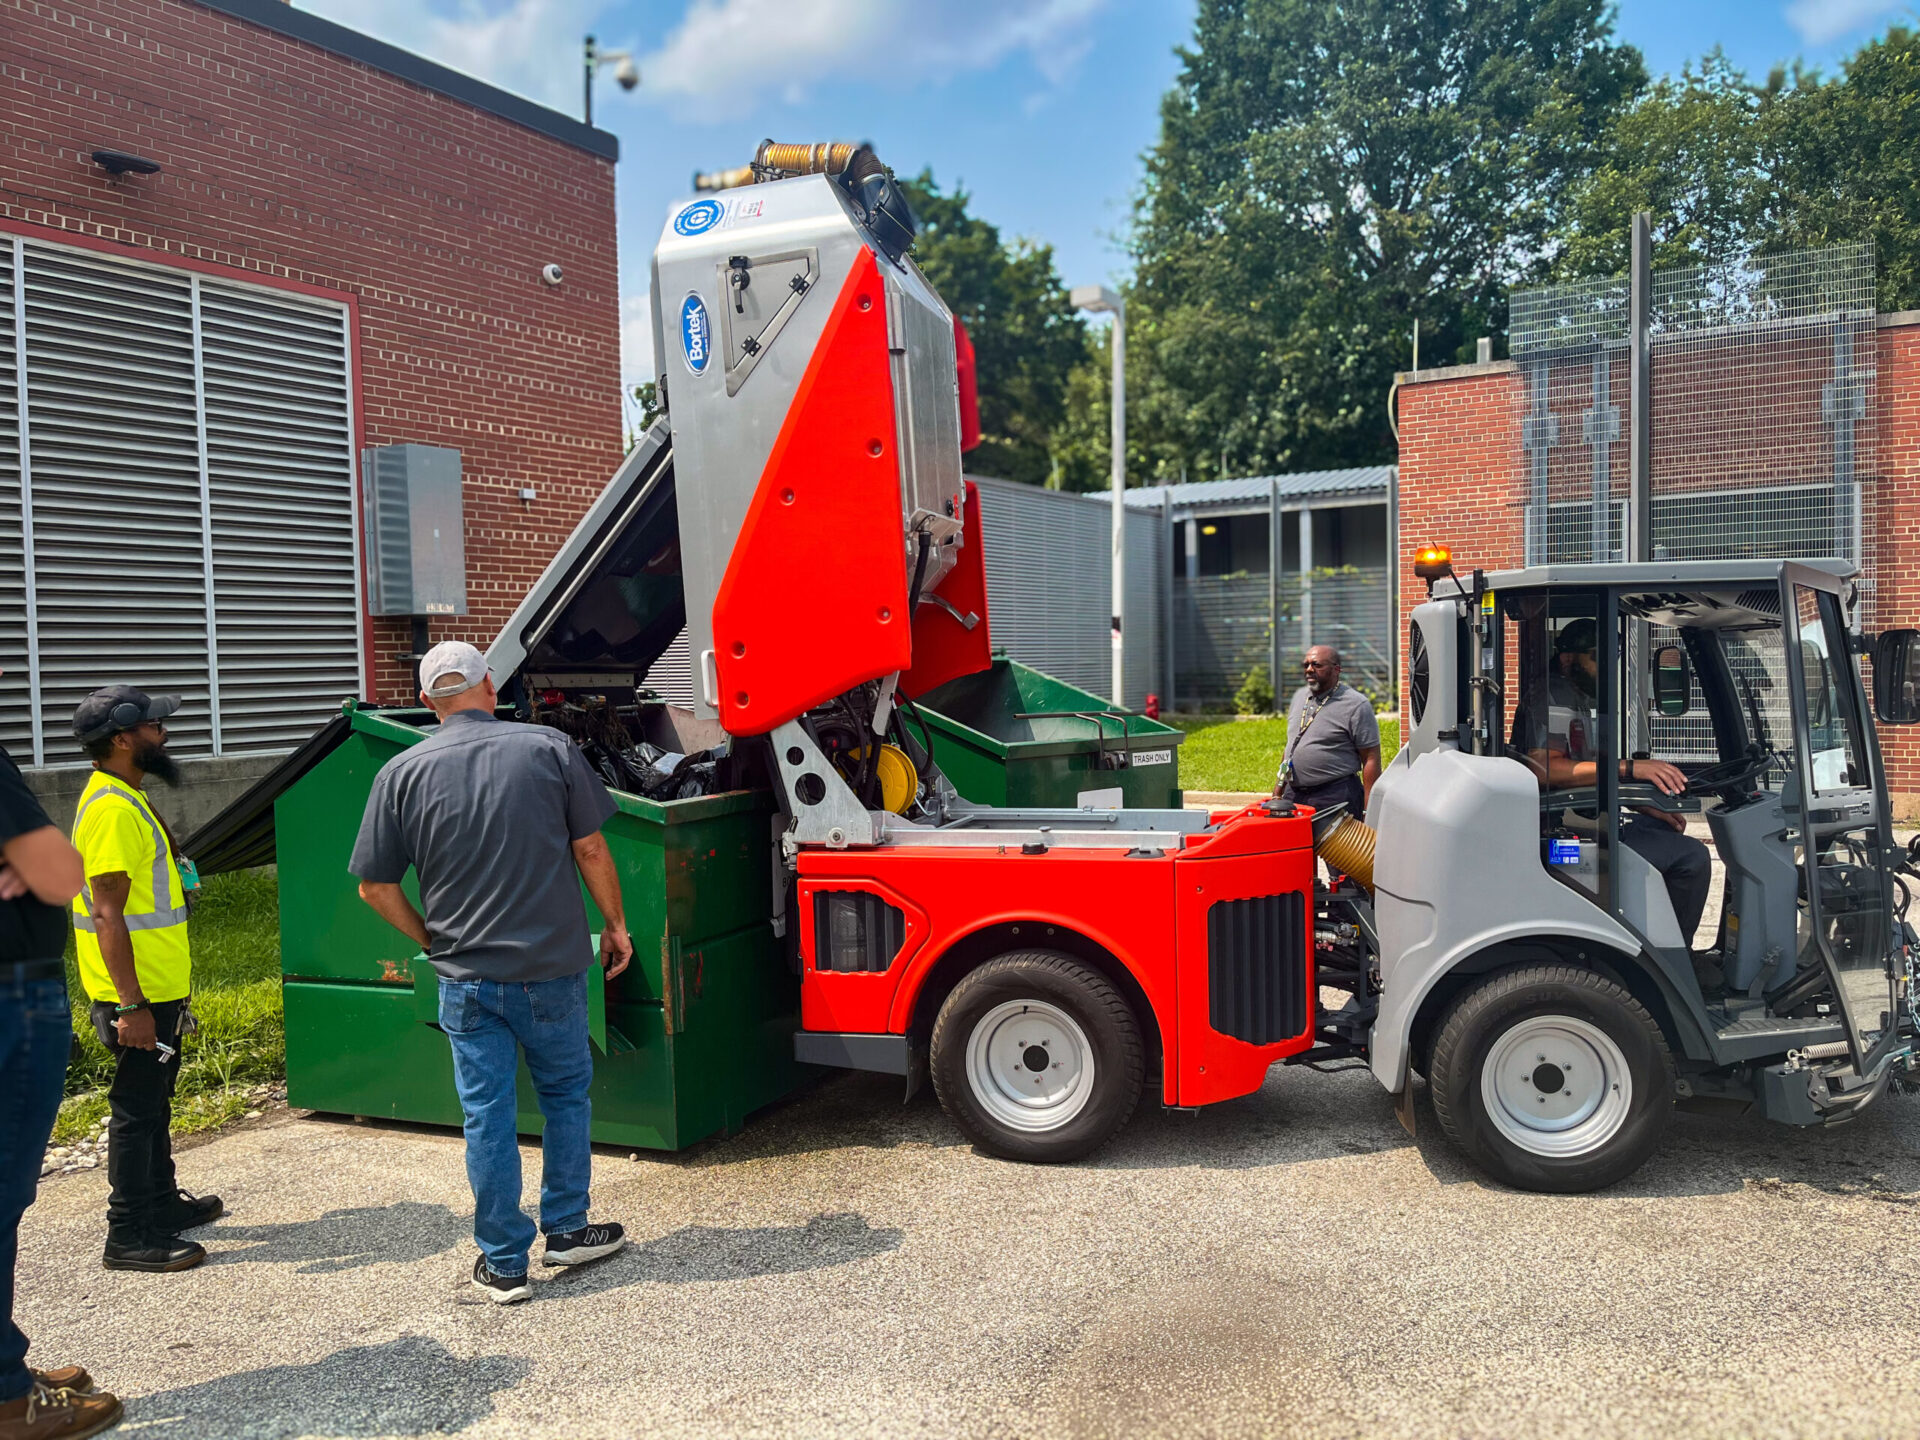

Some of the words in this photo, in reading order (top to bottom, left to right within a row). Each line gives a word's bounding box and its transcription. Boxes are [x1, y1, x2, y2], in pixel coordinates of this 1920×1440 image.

[686, 304, 704, 361] Bortek
[1134, 754, 1153, 764] TRASH
[1154, 753, 1170, 762] ONLY
